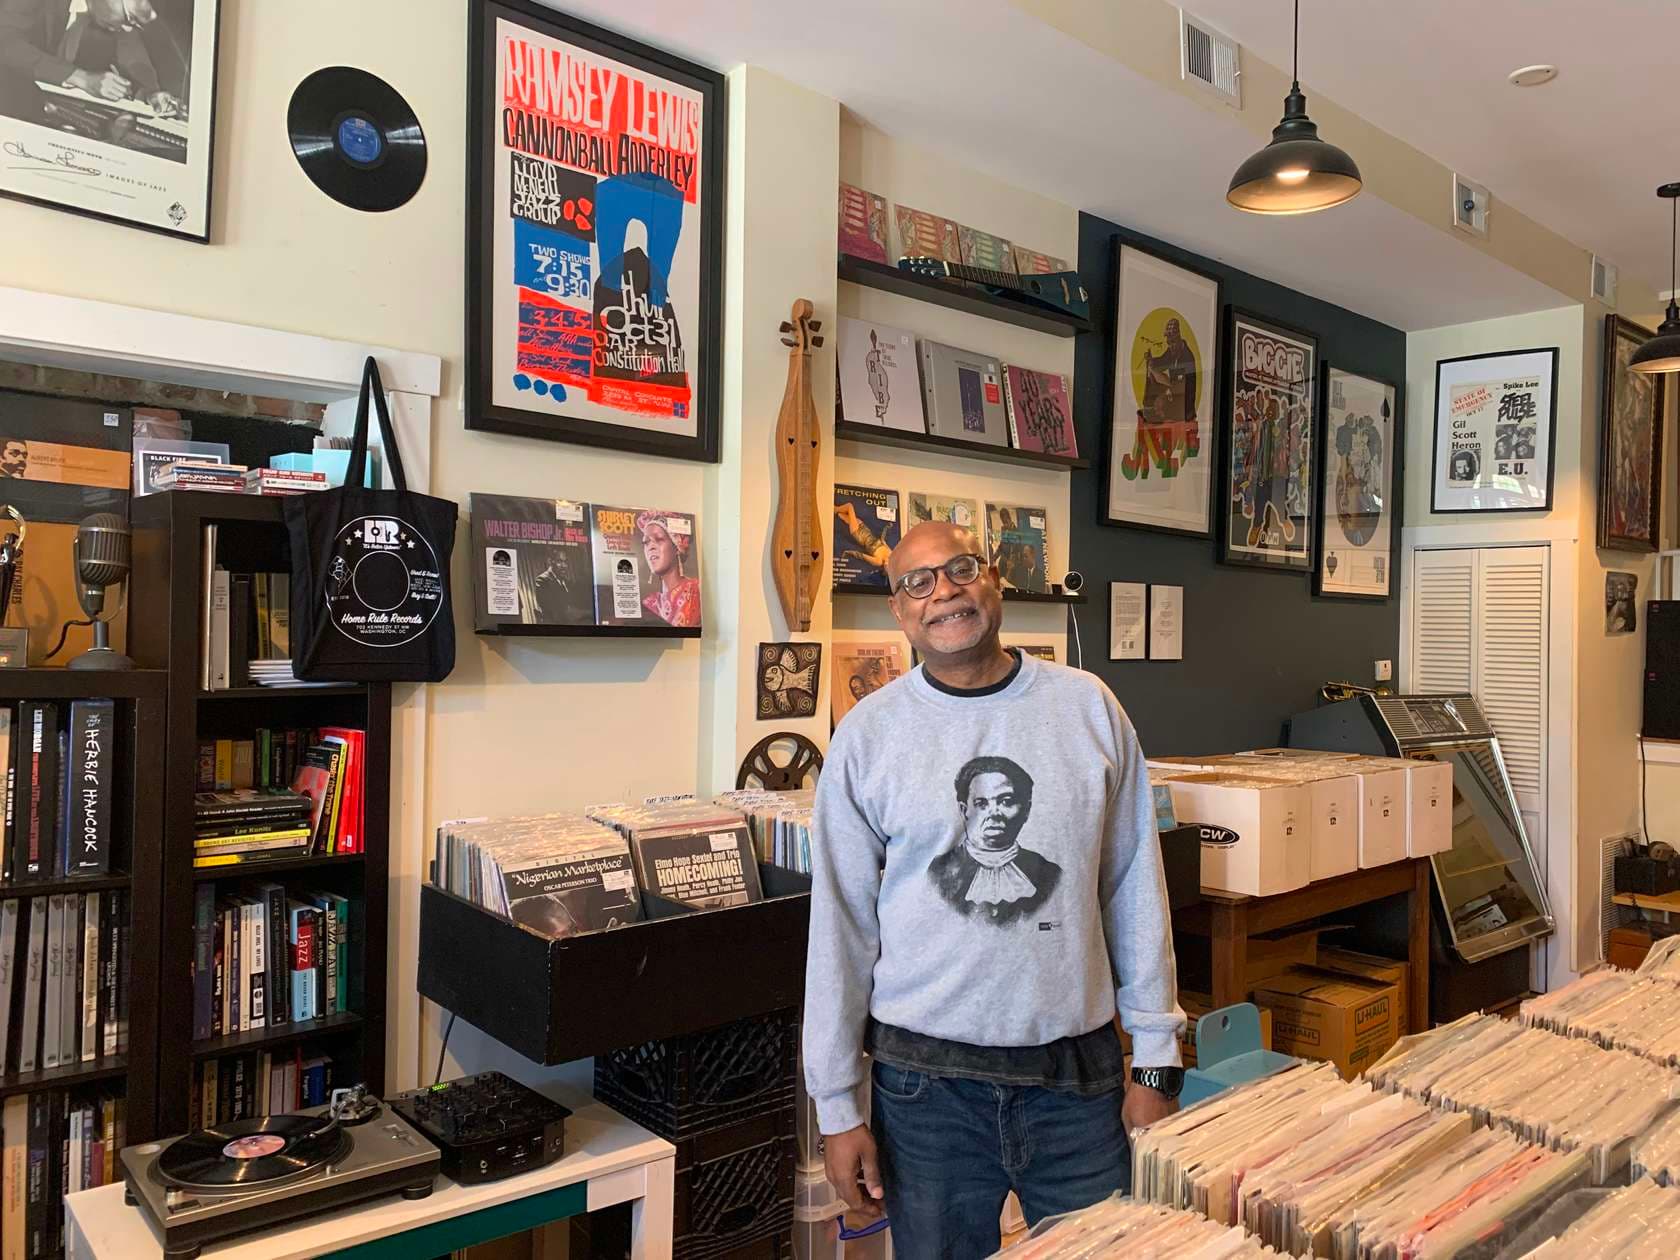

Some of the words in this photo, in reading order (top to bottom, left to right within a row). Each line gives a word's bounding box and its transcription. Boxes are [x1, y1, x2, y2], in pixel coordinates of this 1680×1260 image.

[504, 38, 618, 133] RAMSEY
[627, 75, 699, 155] LEWIS
[503, 107, 613, 176] CANNONBALL
[617, 134, 694, 191] ADDERLEY
[513, 160, 558, 181] LLOYD
[512, 202, 561, 224] GROUP
[528, 243, 557, 258] TWO
[560, 250, 591, 265] SHOWS
[532, 254, 583, 280] 7:15
[545, 274, 591, 298] 9:30
[600, 305, 652, 345] Oct
[650, 317, 682, 348] 31
[666, 345, 686, 374] Hall
[1244, 337, 1303, 382] BIGGIE
[1503, 382, 1523, 391] Spike
[1500, 392, 1532, 407] STEEL
[1497, 401, 1537, 423] PULSE
[1452, 420, 1466, 429] Gil
[1451, 441, 1480, 450] Heron
[1452, 431, 1477, 440] Scott
[1498, 462, 1528, 476] E.U.
[834, 488, 887, 500] RETCHING
[865, 498, 887, 507] OUT
[597, 510, 636, 523] SHIRLEY
[484, 519, 520, 538] WALTER
[521, 521, 552, 540] BISHOP
[600, 520, 635, 535] SCOTT
[341, 613, 366, 624] Home
[367, 612, 389, 624] Rule
[390, 613, 423, 624] Records
[33, 722, 43, 753] MORGAN
[84, 729, 100, 785] HERBIE
[82, 789, 98, 853] HANCOCK
[235, 827, 247, 835] Lee
[1200, 828, 1225, 841] CW
[655, 858, 673, 869] Elmo
[672, 856, 691, 868] Hope
[691, 852, 713, 864] Sextet
[713, 850, 727, 861] and
[726, 849, 740, 860] Trio
[656, 858, 744, 888] HOMECOMING!
[543, 882, 561, 892] OSCAR
[561, 880, 586, 889] PETERSON
[586, 877, 598, 885] TRIO
[298, 933, 310, 964] Jazz
[1357, 998, 1388, 1025] U-HAUL
